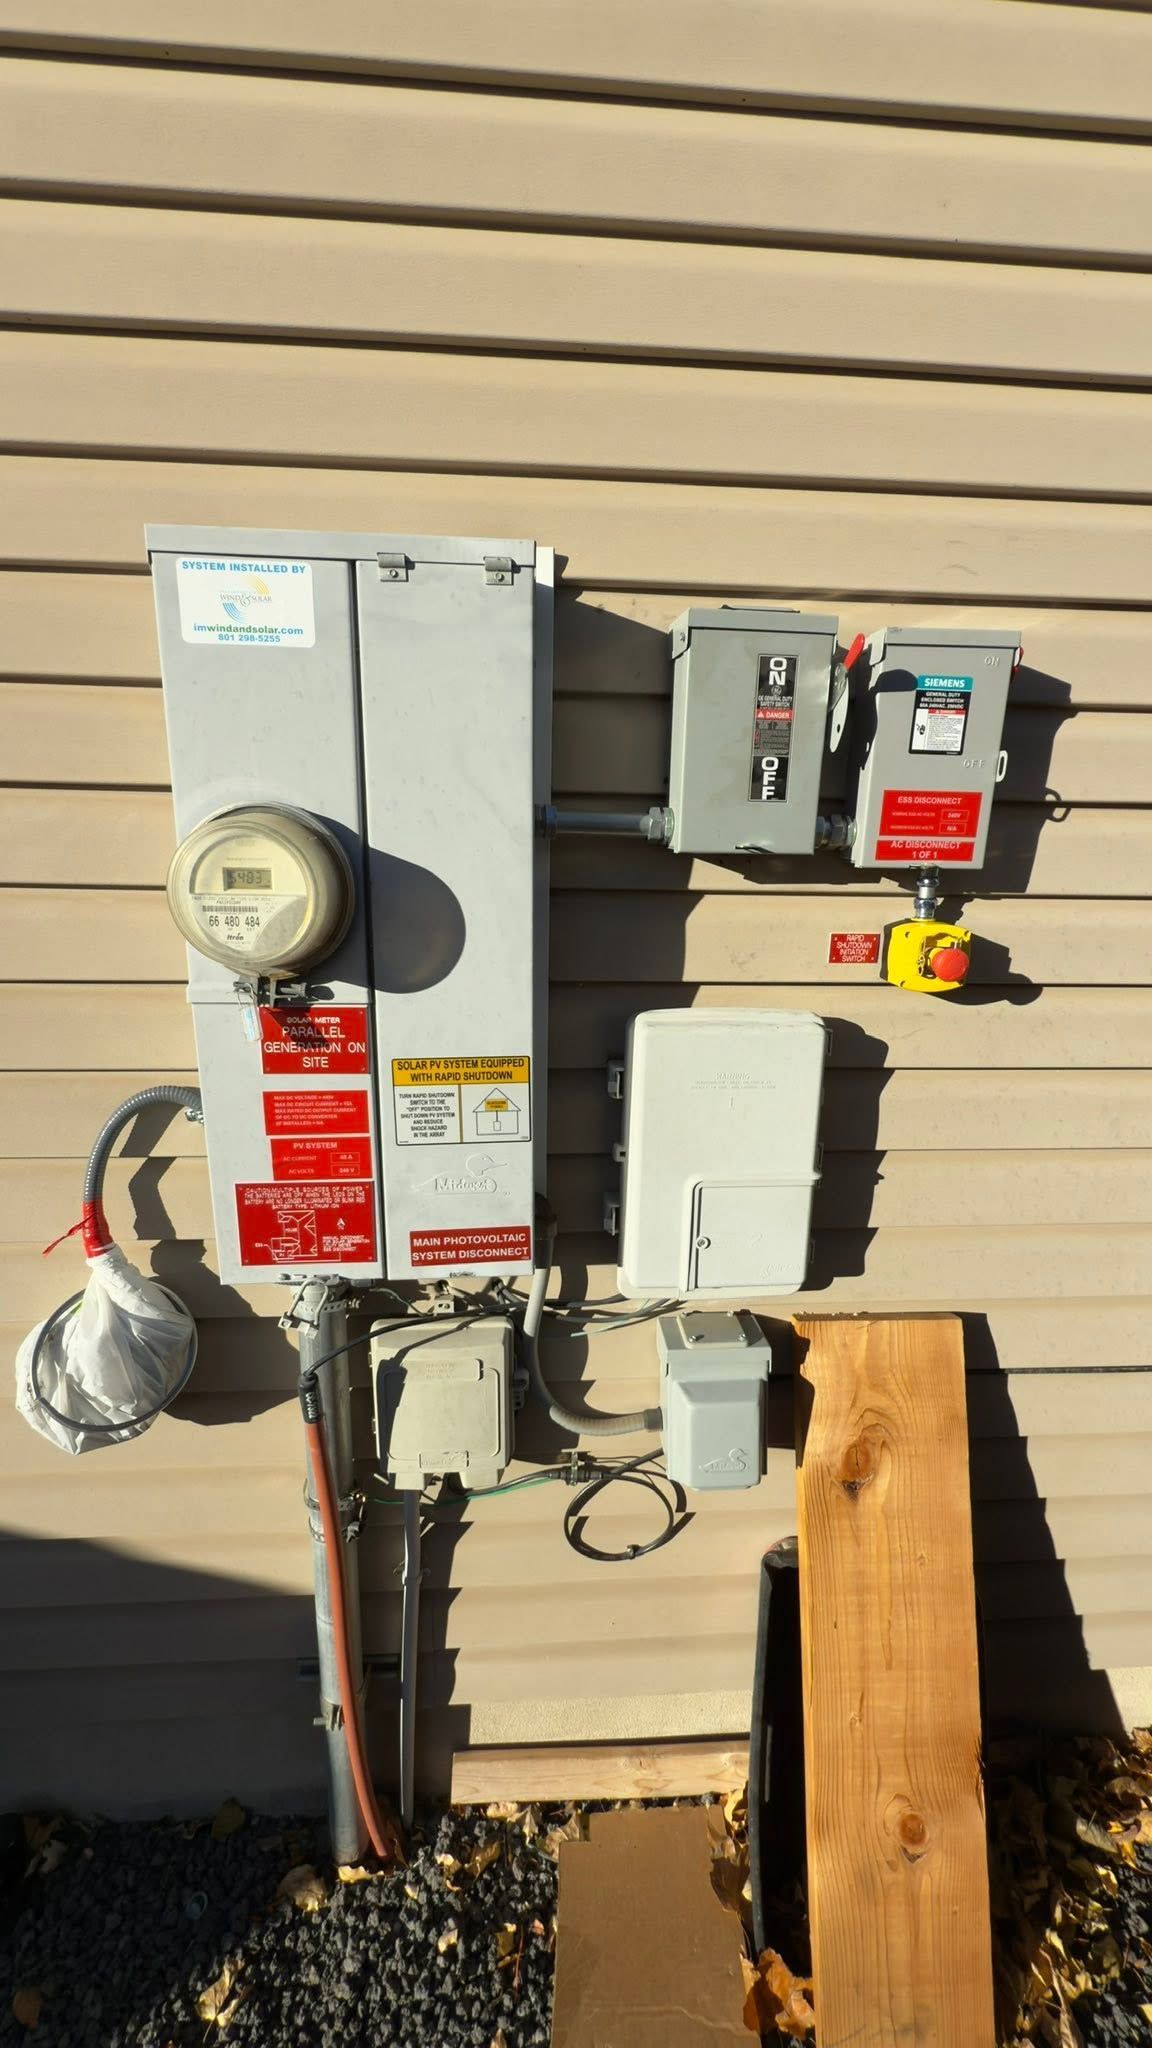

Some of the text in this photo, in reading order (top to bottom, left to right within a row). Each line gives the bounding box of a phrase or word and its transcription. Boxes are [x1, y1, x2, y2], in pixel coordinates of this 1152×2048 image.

[182, 560, 306, 574] SYSTEM INSTALLED BY
[194, 623, 304, 635] imwindandsolar.com
[238, 634, 281, 643] 298-5255
[984, 656, 1000, 666] ON
[768, 657, 788, 686] ON
[924, 678, 966, 688] SIEMENS
[766, 711, 790, 719] DANGER
[761, 756, 779, 800] OFF
[897, 796, 913, 804] ESS
[209, 916, 260, 928] 66 480 484
[282, 1026, 346, 1038] PARALLEL
[264, 1042, 366, 1053] GENERATION ON
[302, 1056, 329, 1068] SITE
[397, 1058, 524, 1070] SOLAR PV SYSTEM EQUIPPED
[410, 1071, 512, 1082] WITH RAPID SHUTDOWN
[413, 1233, 526, 1247] MAIN PHOTOVOLTAIC
[412, 1247, 528, 1261] SYSTEM DISCONNECT
